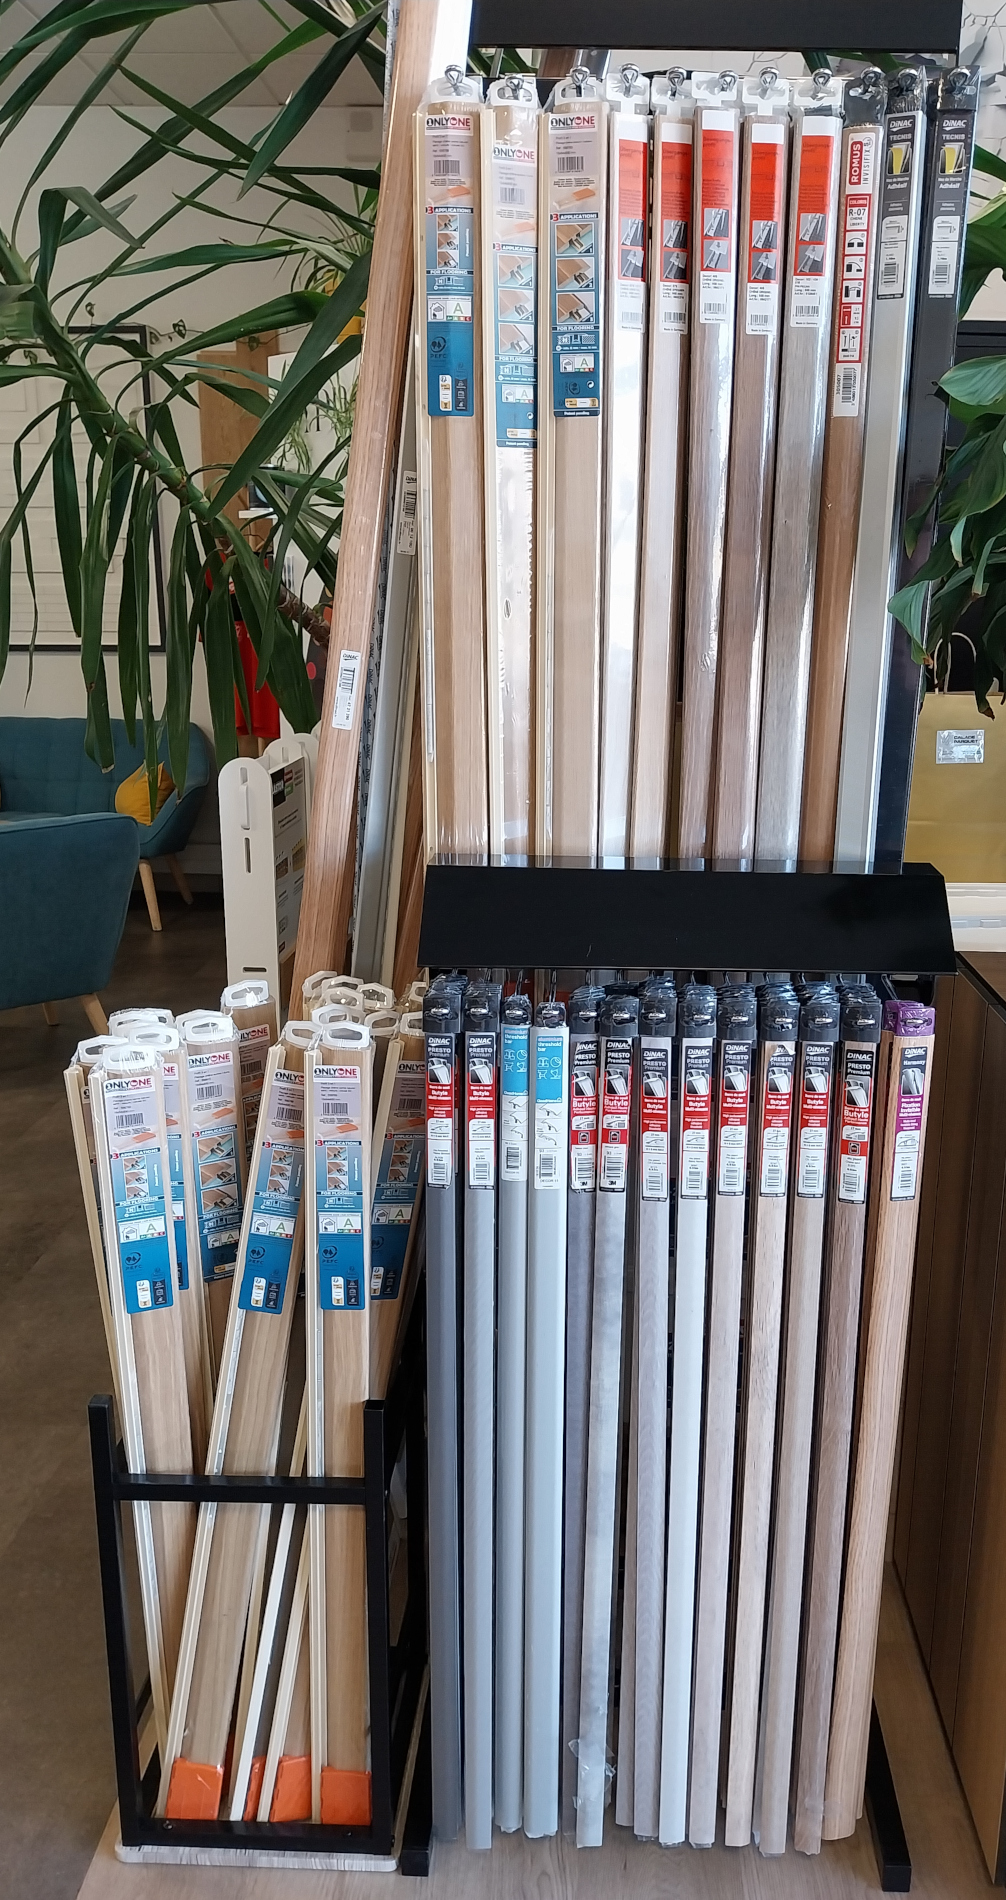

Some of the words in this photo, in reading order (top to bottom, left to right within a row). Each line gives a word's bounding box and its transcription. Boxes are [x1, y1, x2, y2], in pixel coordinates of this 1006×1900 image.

[551, 116, 595, 127] ONLYONE
[851, 143, 861, 183] ROMUS
[862, 149, 871, 185] INVISIFIX
[848, 208, 866, 216] R-07
[453, 302, 464, 315] A
[580, 358, 589, 367] A
[399, 1063, 425, 1071] ONLYO
[314, 1068, 357, 1076] ONLYONE
[275, 1071, 304, 1083] ONLYO
[105, 1078, 152, 1091] ONLYONE
[573, 1101, 596, 1109] Butyle
[604, 1099, 628, 1107] Butyle
[844, 1110, 869, 1118] Butyle
[395, 1209, 404, 1218] A
[276, 1222, 286, 1232] A
[343, 1218, 353, 1227] A
[146, 1223, 156, 1233] A
